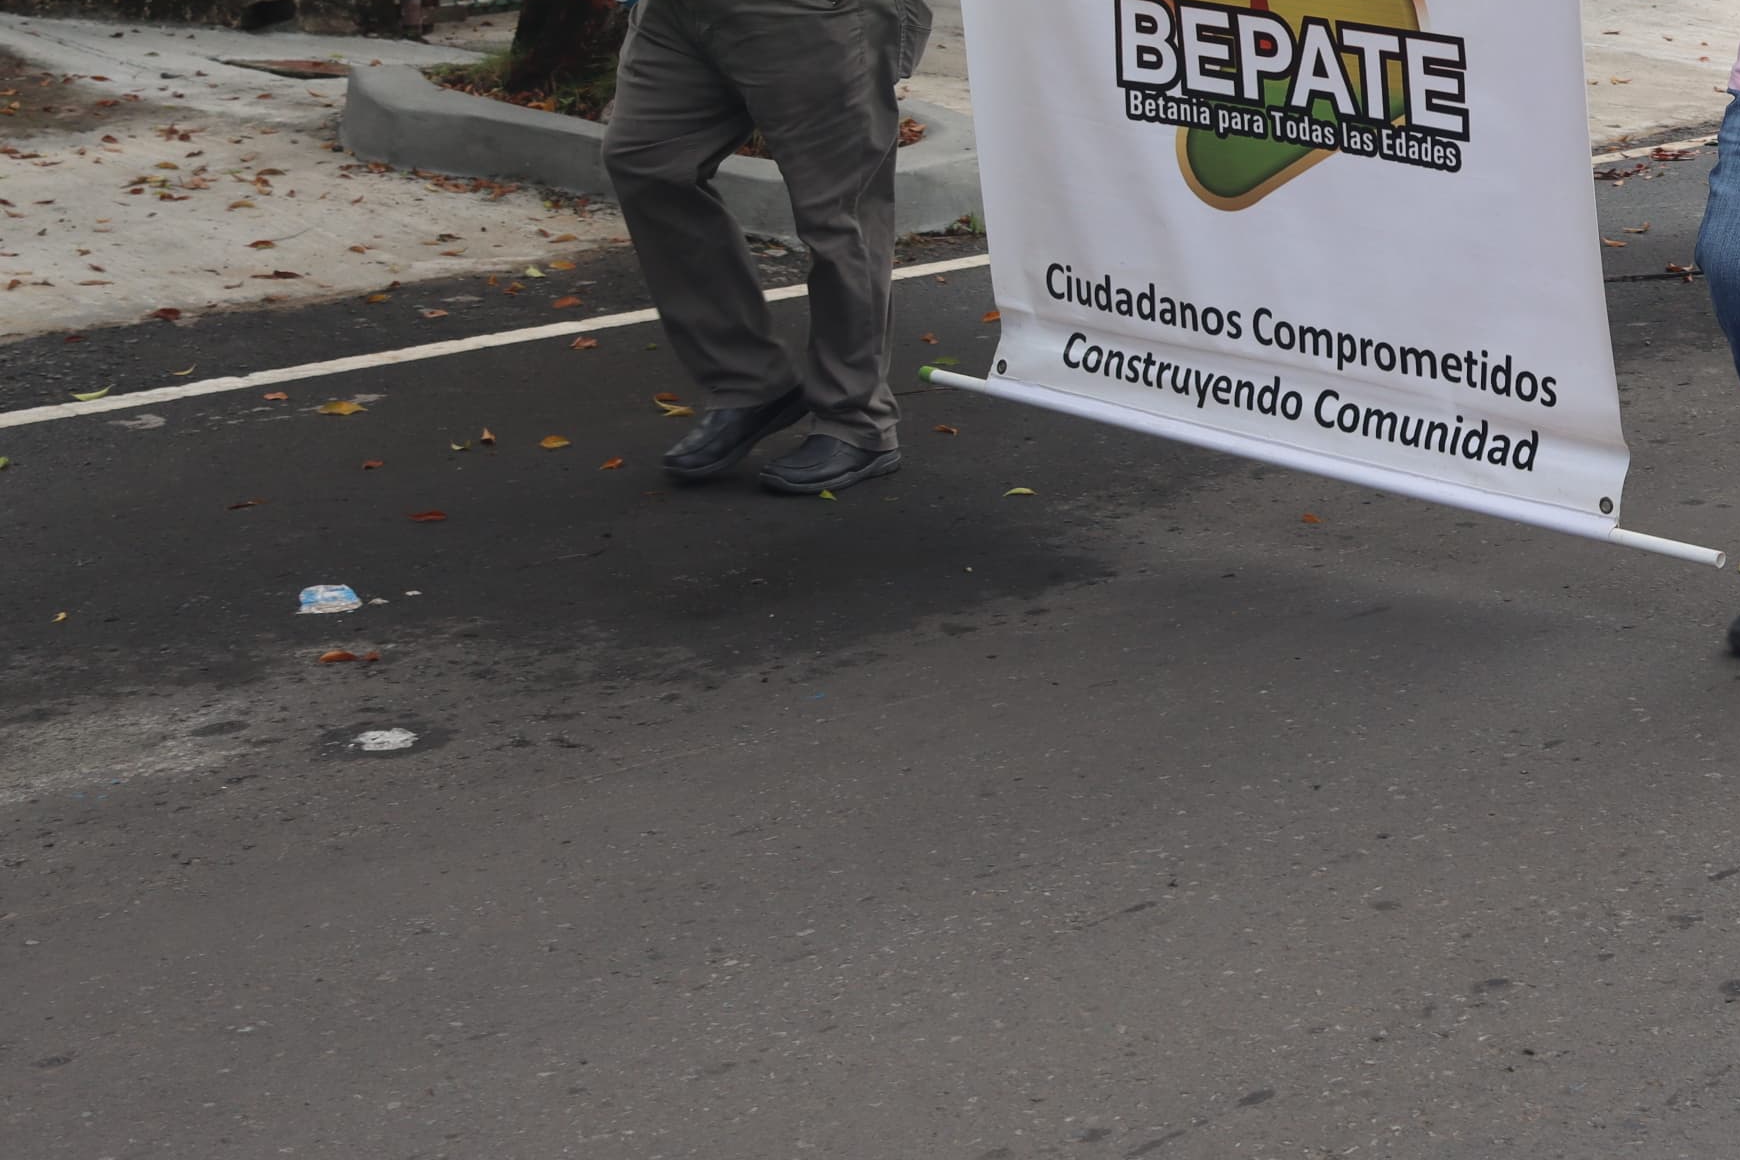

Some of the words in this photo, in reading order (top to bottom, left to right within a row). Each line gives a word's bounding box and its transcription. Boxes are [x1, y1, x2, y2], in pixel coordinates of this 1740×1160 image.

[1129, 91, 1211, 126] Betania
[1218, 109, 1265, 134] para
[1270, 110, 1335, 146] Todas
[1342, 126, 1375, 153] las
[1382, 128, 1457, 168] Edades
[1045, 262, 1243, 340] Ciudadanos
[1252, 306, 1558, 408] Comprometidos
[1062, 331, 1304, 421] Construyendo
[1313, 388, 1540, 472] Comunidad
